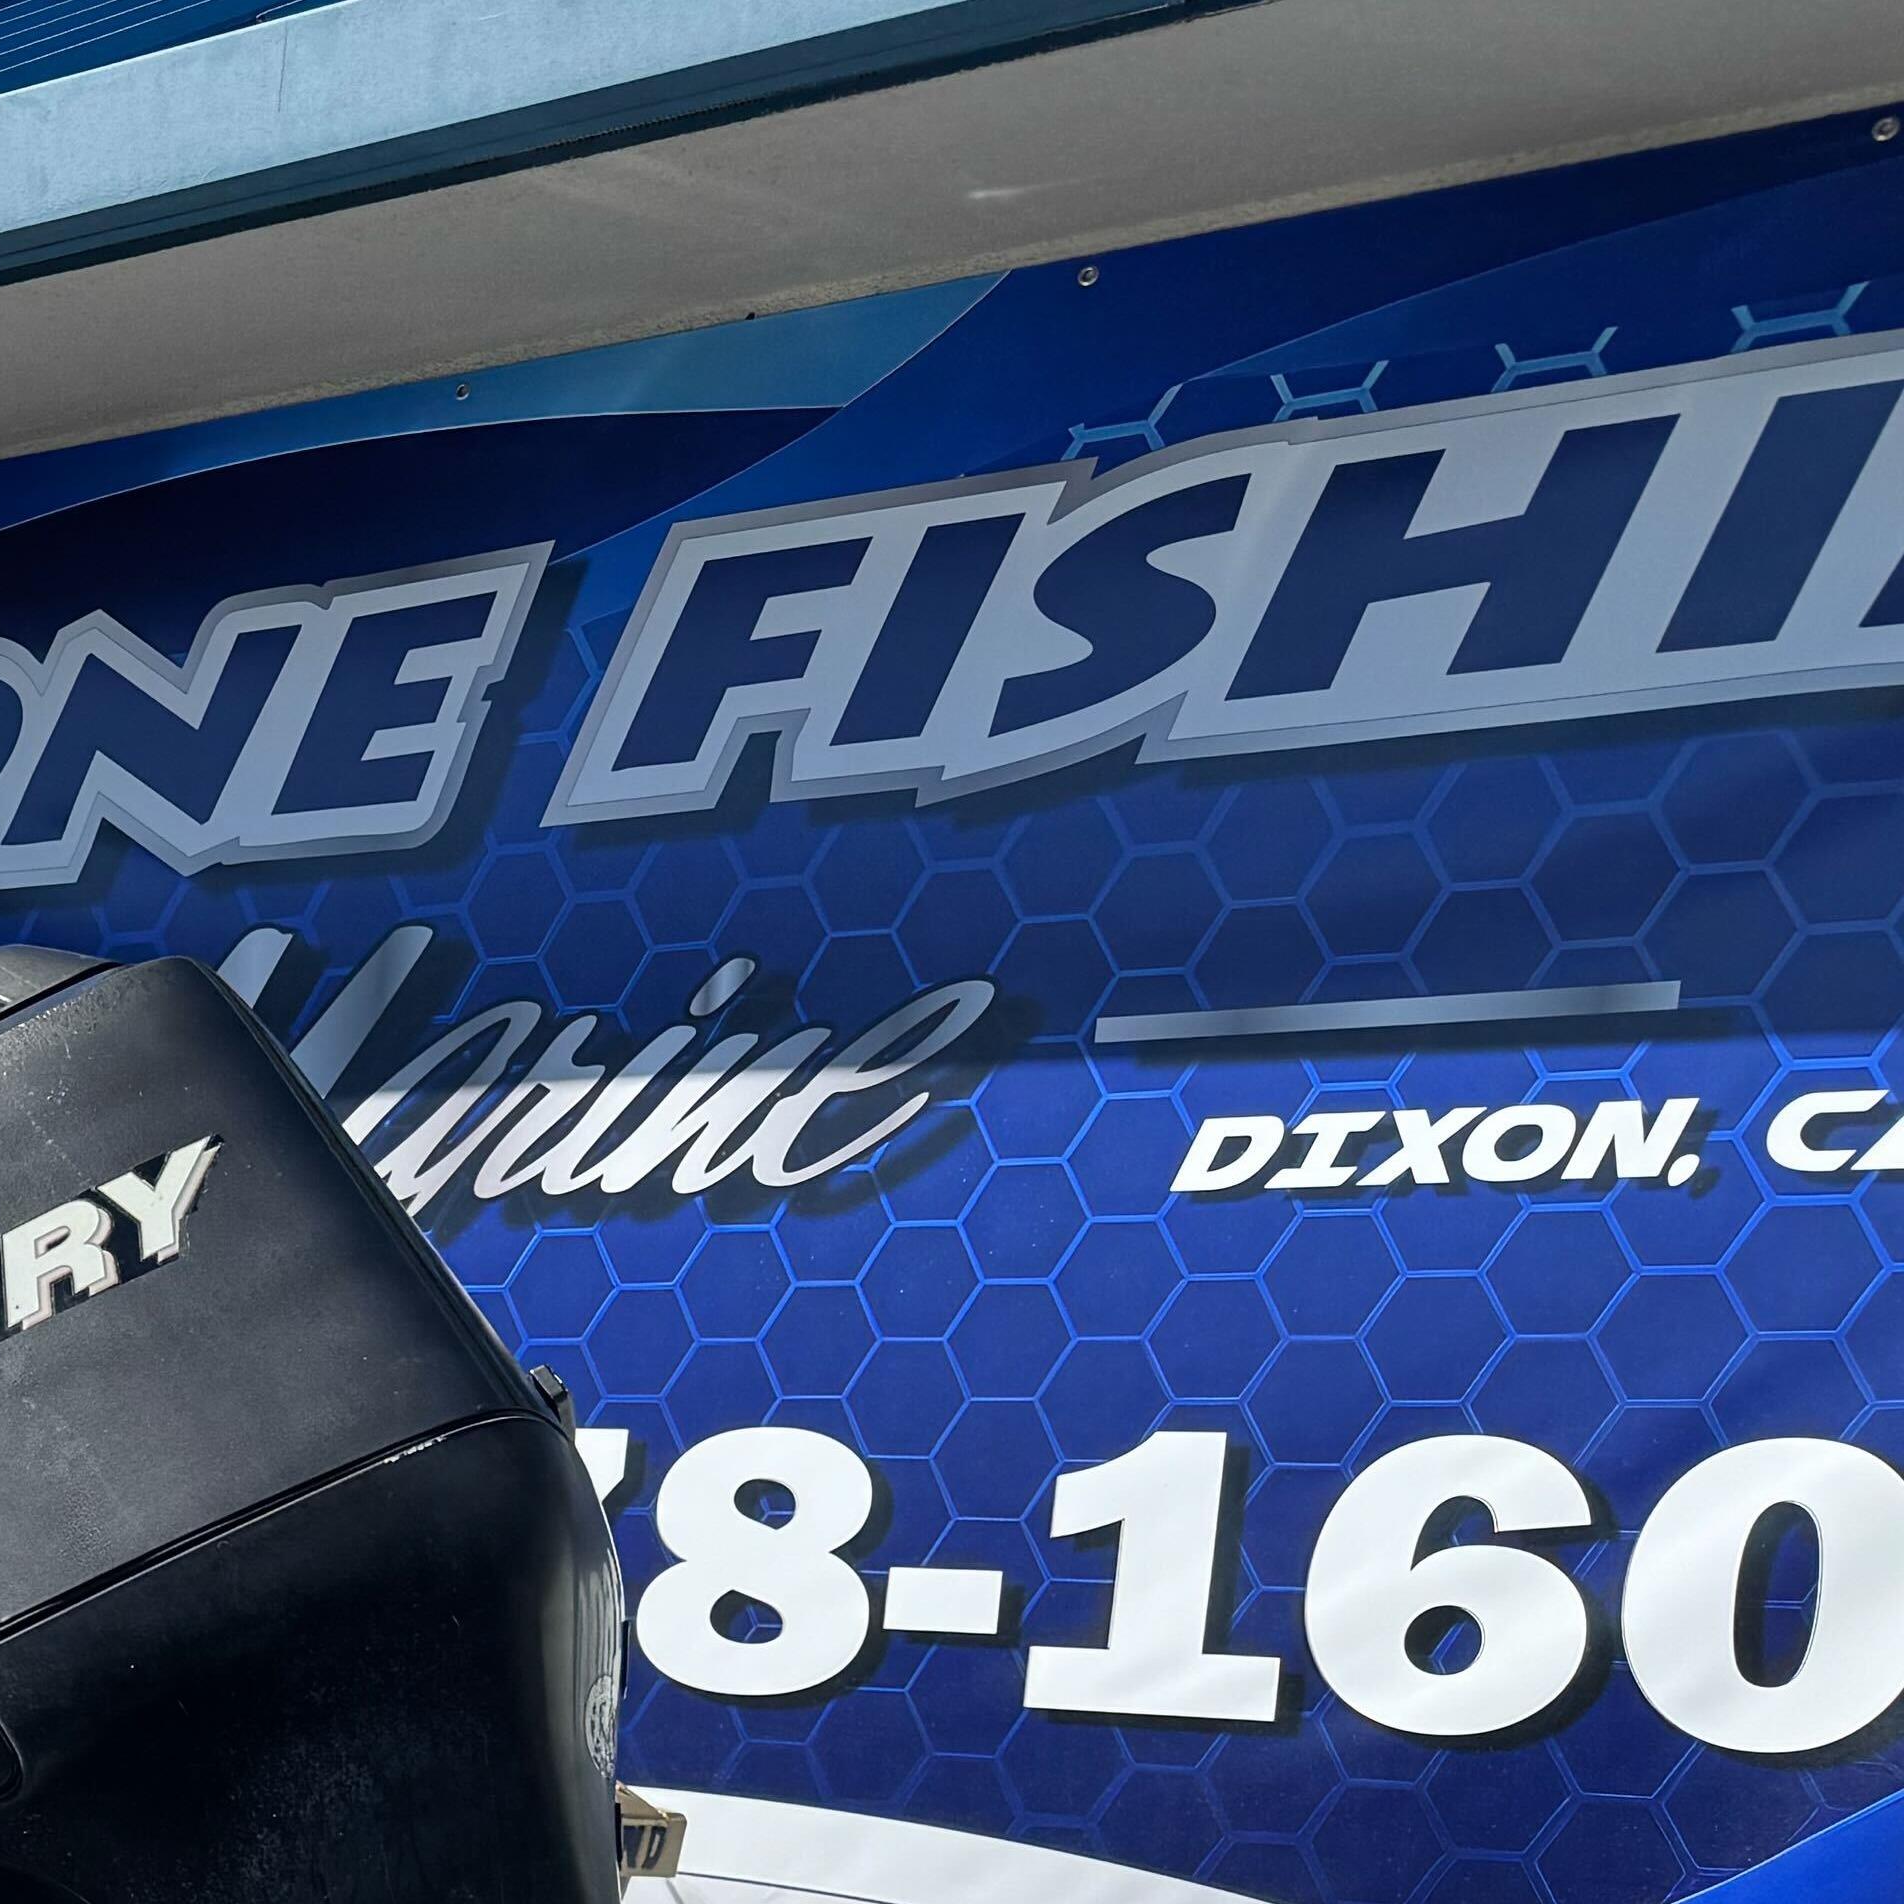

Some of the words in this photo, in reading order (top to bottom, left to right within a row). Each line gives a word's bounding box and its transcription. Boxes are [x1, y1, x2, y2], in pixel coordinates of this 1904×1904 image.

[607, 373, 1904, 772] FISHI
[1170, 1096, 1701, 1188] DIXON,
[574, 1426, 1904, 1754] 8-160
